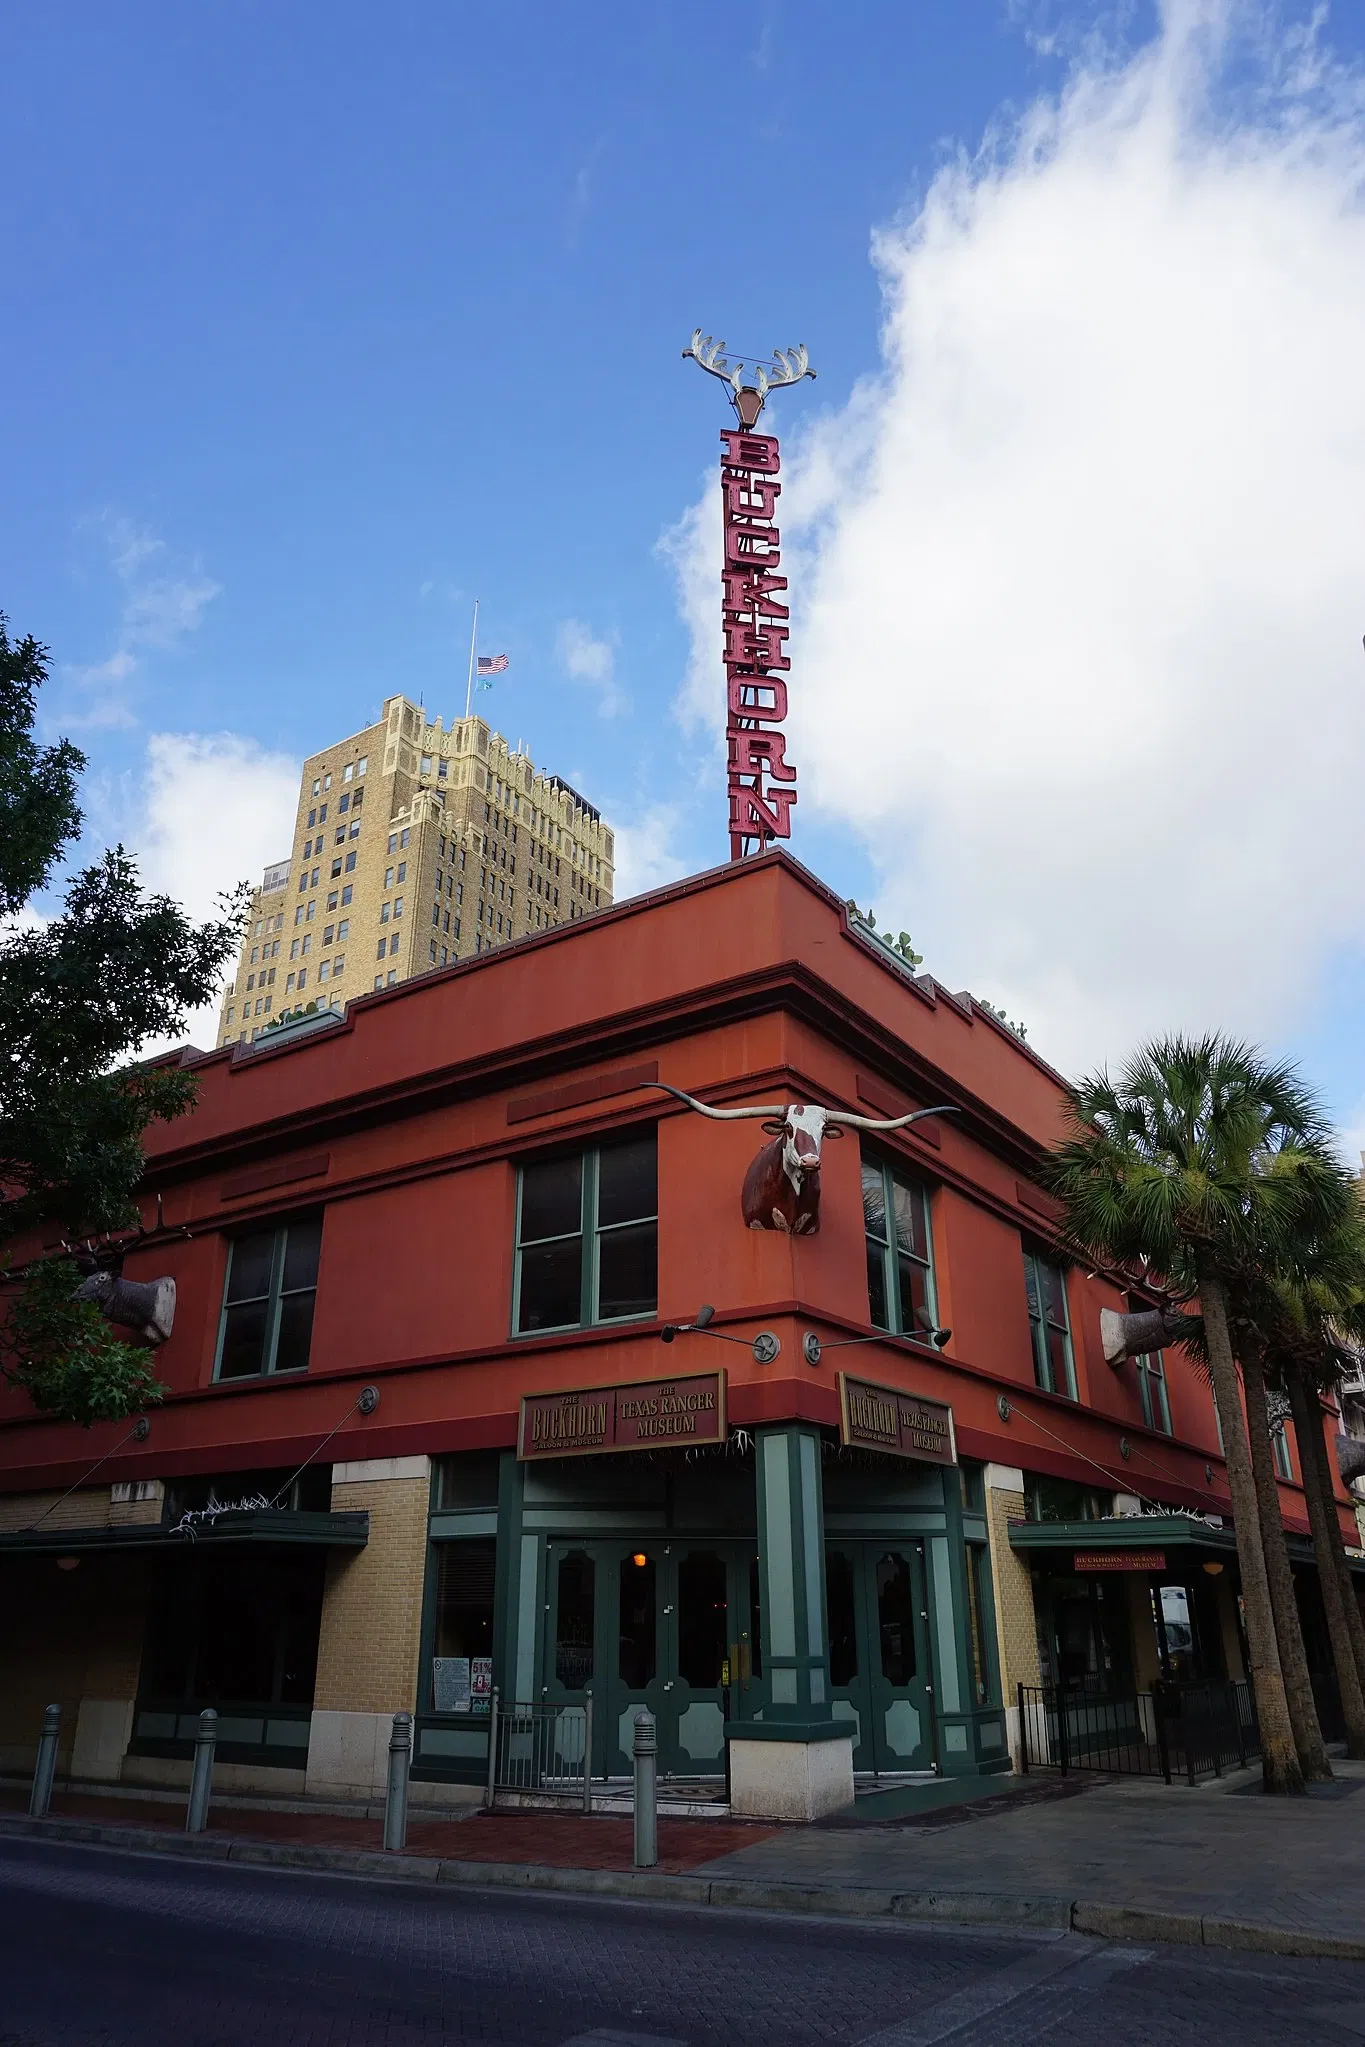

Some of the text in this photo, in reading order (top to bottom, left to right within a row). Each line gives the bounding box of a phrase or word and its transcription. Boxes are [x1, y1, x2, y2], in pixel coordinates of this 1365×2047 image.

[720, 428, 797, 839] BUCKHORN
[560, 1396, 580, 1405] THE
[658, 1386, 676, 1396] THE
[620, 1391, 715, 1419] TEXAS RANGER
[848, 1390, 897, 1436] BUCKHORN
[531, 1402, 607, 1442] BUCKHORN
[637, 1415, 696, 1438] MUSEUM
[533, 1438, 603, 1450] SALOON & MUSEUM
[912, 1432, 943, 1453] MUSEUM
